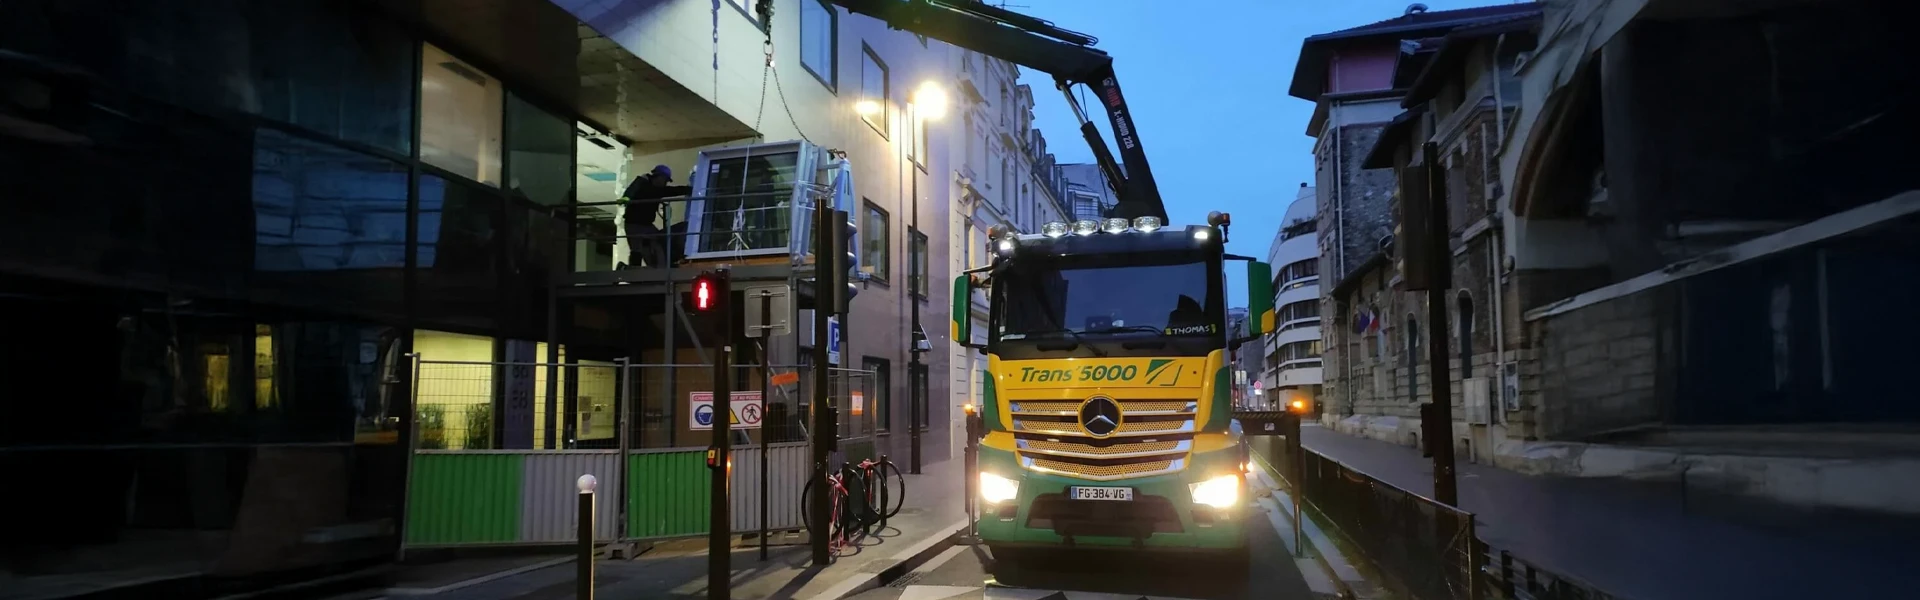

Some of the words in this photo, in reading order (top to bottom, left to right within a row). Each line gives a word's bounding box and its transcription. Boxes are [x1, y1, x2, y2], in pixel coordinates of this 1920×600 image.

[1172, 325, 1210, 335] THOMAS
[833, 328, 840, 347] P
[1078, 488, 1125, 499] FG-384-VG
